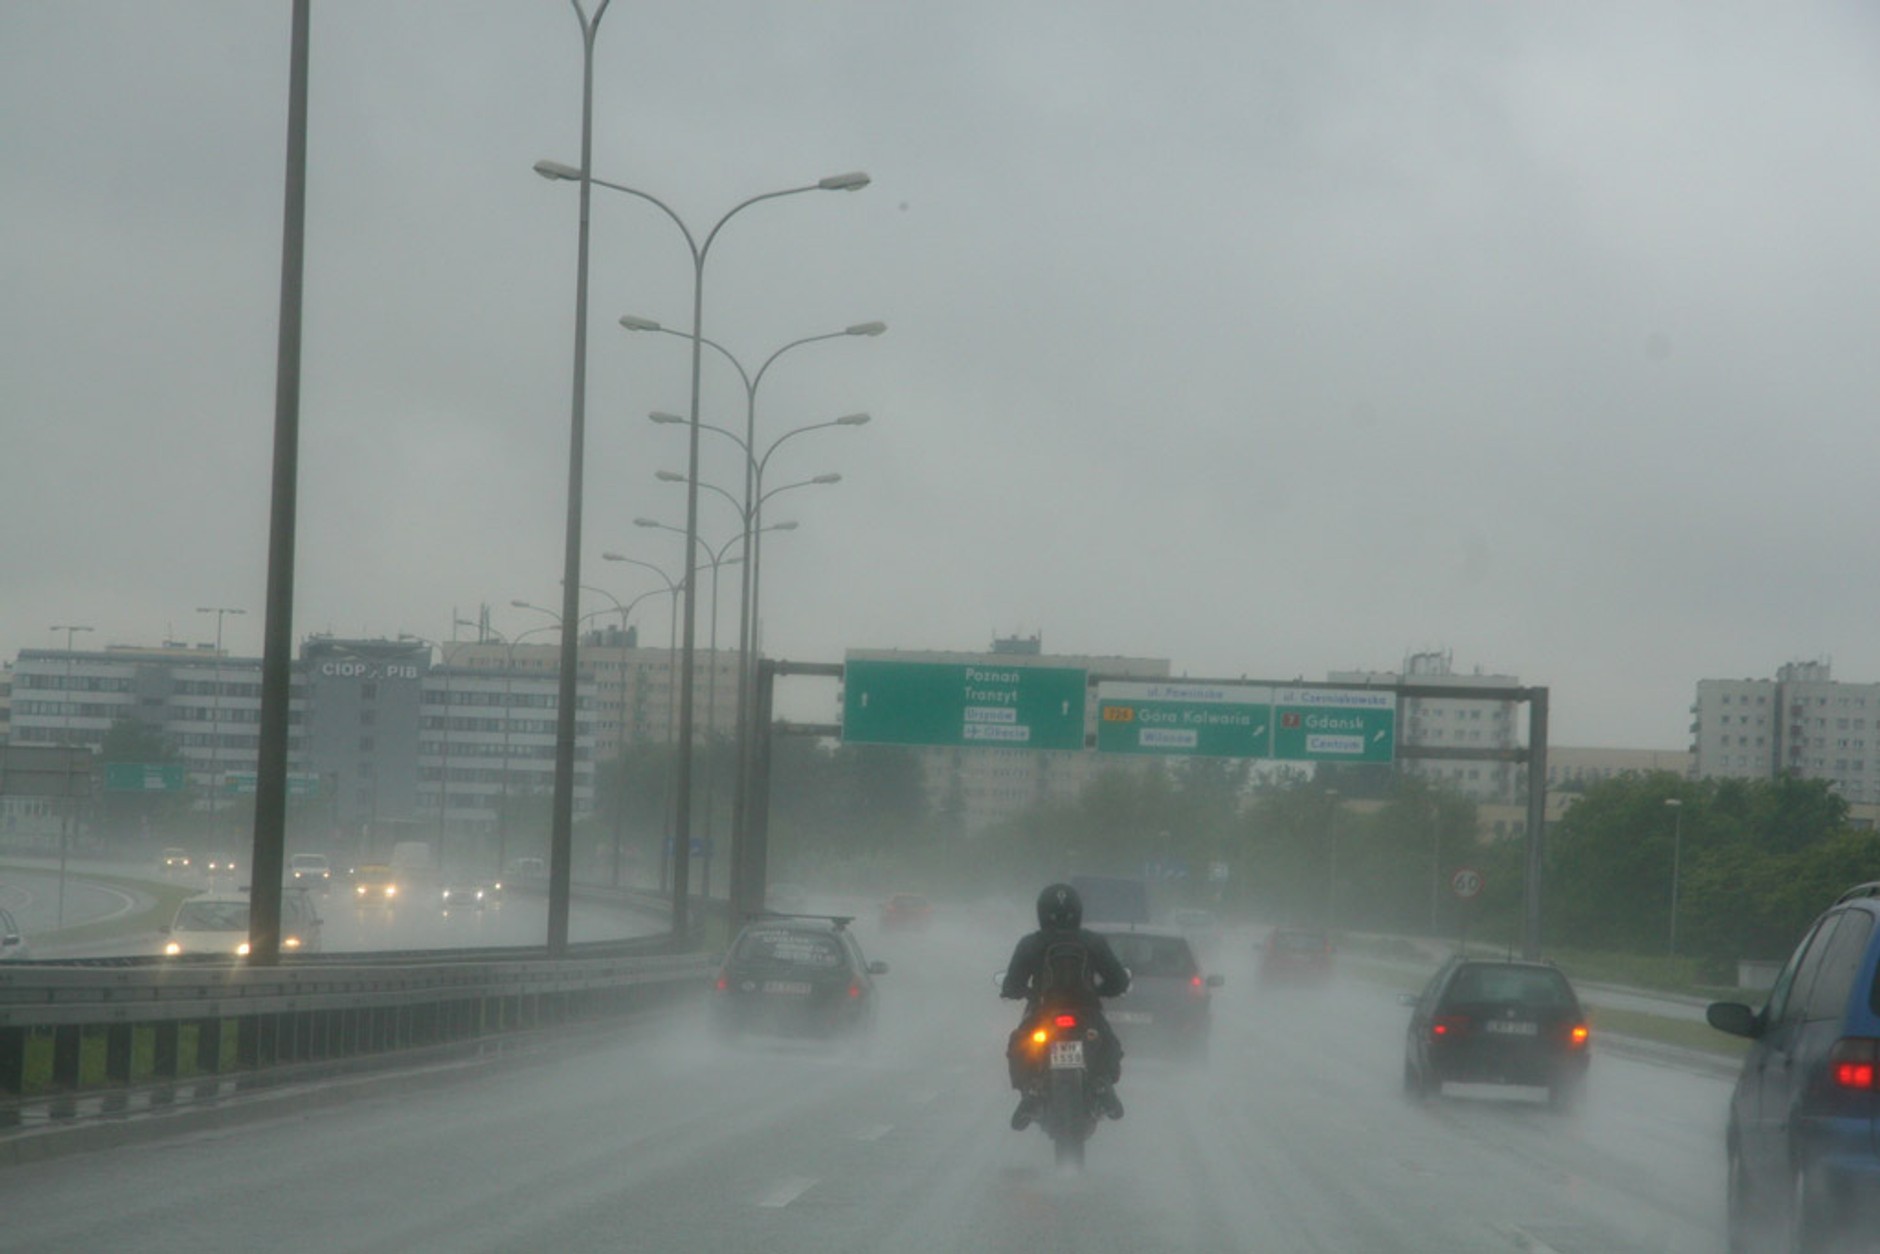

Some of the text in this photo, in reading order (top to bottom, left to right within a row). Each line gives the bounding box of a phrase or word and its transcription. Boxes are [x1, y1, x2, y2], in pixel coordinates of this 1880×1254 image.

[322, 662, 417, 679] CIOP PIB
[964, 686, 1018, 705] Tranzyt
[1183, 709, 1251, 725] Kalwaria
[1311, 737, 1361, 750] Centrum
[1455, 875, 1479, 891] 60
